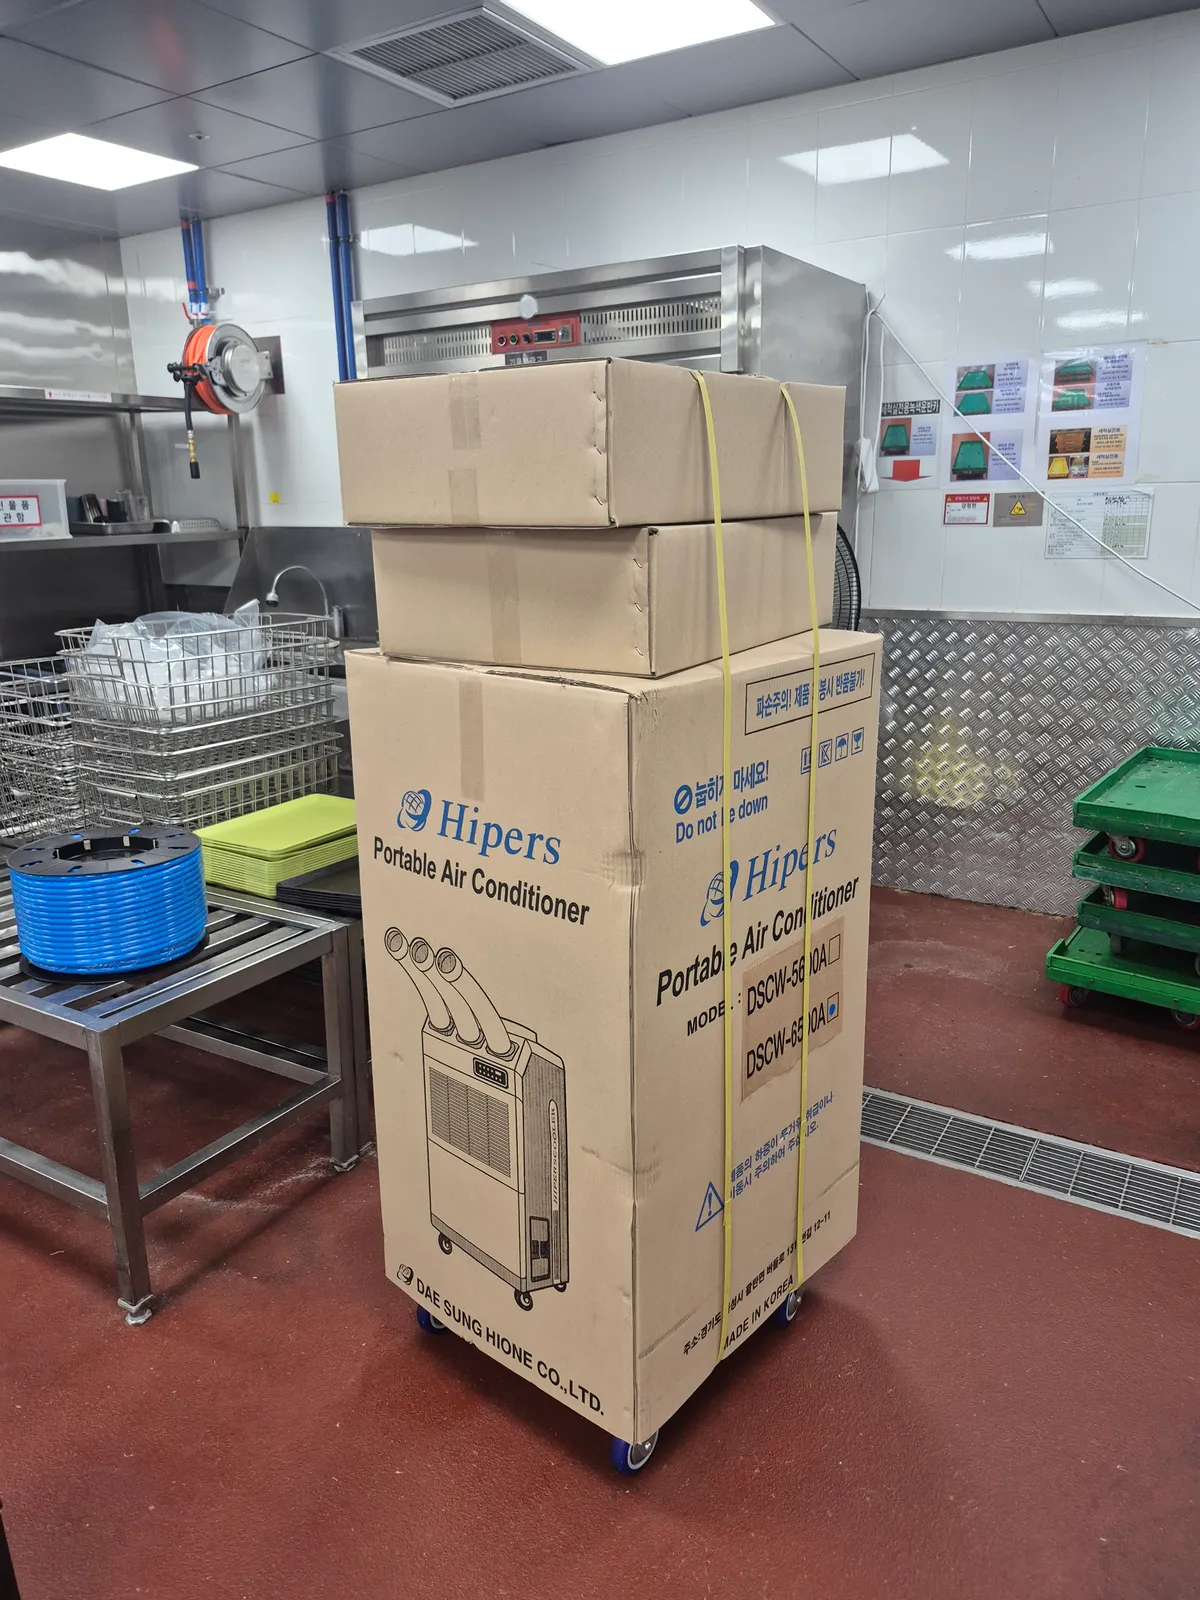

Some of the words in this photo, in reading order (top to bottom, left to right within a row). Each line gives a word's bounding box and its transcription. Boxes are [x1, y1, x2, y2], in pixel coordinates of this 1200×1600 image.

[756, 688, 792, 718] 파손주의!
[794, 683, 810, 707] 제품
[816, 676, 834, 701] 봉시
[836, 668, 866, 696] 반품불가!
[734, 760, 769, 793] 마세요!
[437, 799, 561, 865] Hipers
[676, 821, 694, 843] Do
[697, 811, 717, 835] not
[738, 795, 768, 819] down
[374, 836, 437, 880] Portable
[441, 859, 467, 889] Air
[472, 868, 590, 926] Conditioner
[742, 829, 837, 902] Hipers
[742, 921, 769, 960] Air
[755, 1135, 778, 1162] 하중이
[805, 1091, 833, 1121] 취급이나
[754, 1145, 785, 1179] 주의하여
[813, 1209, 831, 1232] 12-11
[416, 1277, 441, 1310] DAE
[443, 1299, 483, 1338] SUNG
[486, 1326, 533, 1370] HIONE
[751, 1305, 762, 1325] IN
[763, 1274, 794, 1313] KOREA
